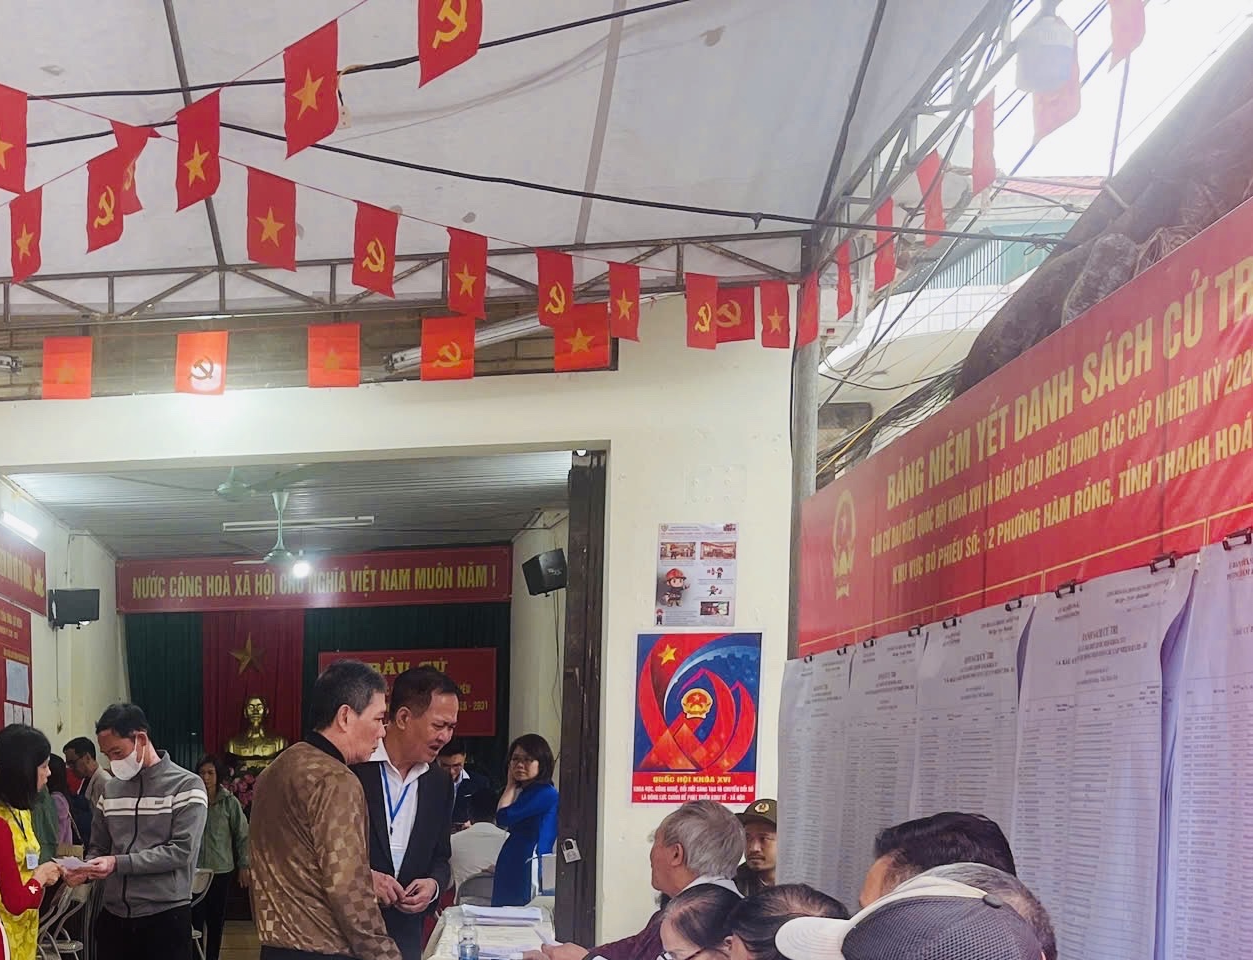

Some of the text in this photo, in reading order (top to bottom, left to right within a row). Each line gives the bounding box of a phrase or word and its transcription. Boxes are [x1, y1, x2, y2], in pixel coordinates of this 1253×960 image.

[887, 456, 925, 511] BẢNG
[929, 429, 971, 489] NIÊM
[976, 395, 1009, 462] YẾT
[1014, 366, 1075, 443] DANH
[1081, 317, 1153, 405] SÁCH
[1163, 268, 1209, 360] CỬ
[1046, 432, 1068, 479] BIỂU
[1102, 410, 1124, 452] CÁC
[1128, 390, 1151, 440] CẤP
[1155, 376, 1199, 428] NHIỆM
[1203, 358, 1221, 406] KỲ
[938, 534, 964, 569] PHIẾU
[997, 507, 1041, 547] PHƯỜNG
[1043, 495, 1070, 528] HÀM
[1118, 460, 1152, 499] TỈNH
[1156, 436, 1210, 485] THANH
[133, 570, 165, 599] NƯỚC
[169, 571, 203, 602] CỘNG
[234, 570, 251, 596] XÃ
[255, 569, 275, 600] HỘI
[350, 565, 376, 598] VIỆT
[380, 568, 411, 591] NAM
[414, 562, 453, 590] MUÔN
[457, 561, 487, 588] NĂM
